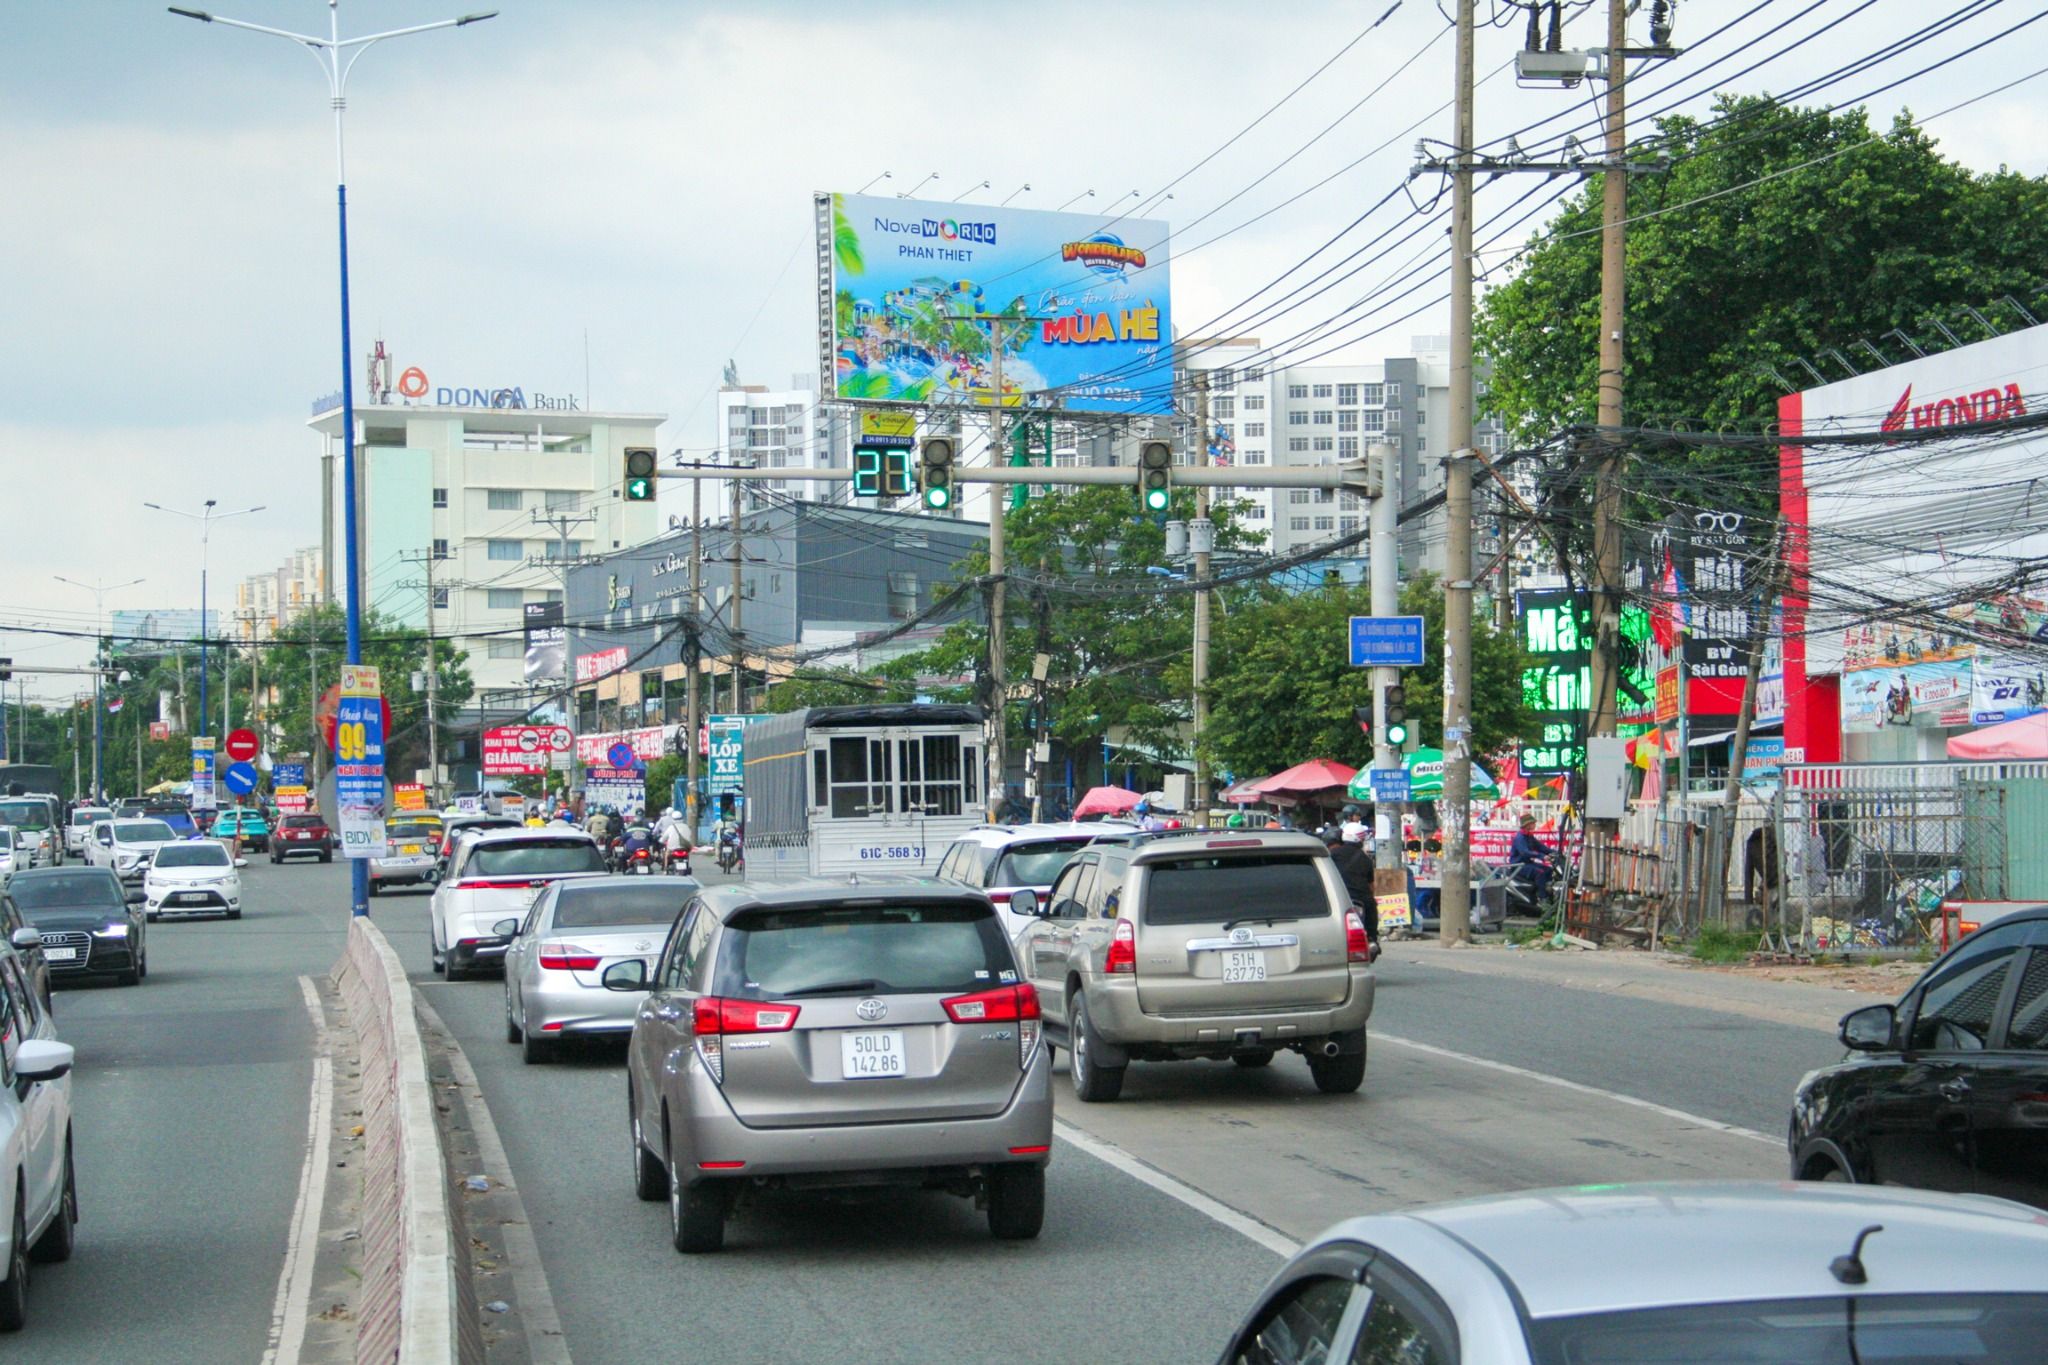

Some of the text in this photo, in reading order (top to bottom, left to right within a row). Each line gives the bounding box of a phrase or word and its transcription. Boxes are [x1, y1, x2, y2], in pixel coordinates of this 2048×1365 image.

[875, 217, 996, 245] NovaWORLD
[899, 245, 973, 262] PHAN THIET
[1062, 241, 1146, 268] WONDERLAND
[1042, 297, 1160, 344] MÙA HÈ
[534, 393, 580, 411] Bank
[1911, 383, 2027, 430] HONDA
[855, 450, 911, 494] 27
[1691, 537, 1704, 545] BV
[1726, 534, 1745, 545] GÒN
[1694, 551, 1743, 591] Mắt
[1707, 647, 1733, 659] BV
[1692, 661, 1748, 676] Sài Gòn
[339, 723, 366, 760] 99
[711, 738, 742, 758] LỐP
[1523, 747, 1558, 768] Sài
[1785, 750, 1803, 762] HEAD
[715, 759, 738, 773] XE
[1416, 765, 1442, 774] MILO
[459, 799, 474, 809] APEX
[345, 831, 372, 845] BIDV
[1232, 953, 1255, 966] 51H
[1225, 967, 1265, 981] 237.79
[855, 1036, 891, 1052] 50LD
[852, 1054, 899, 1073] 142.86
